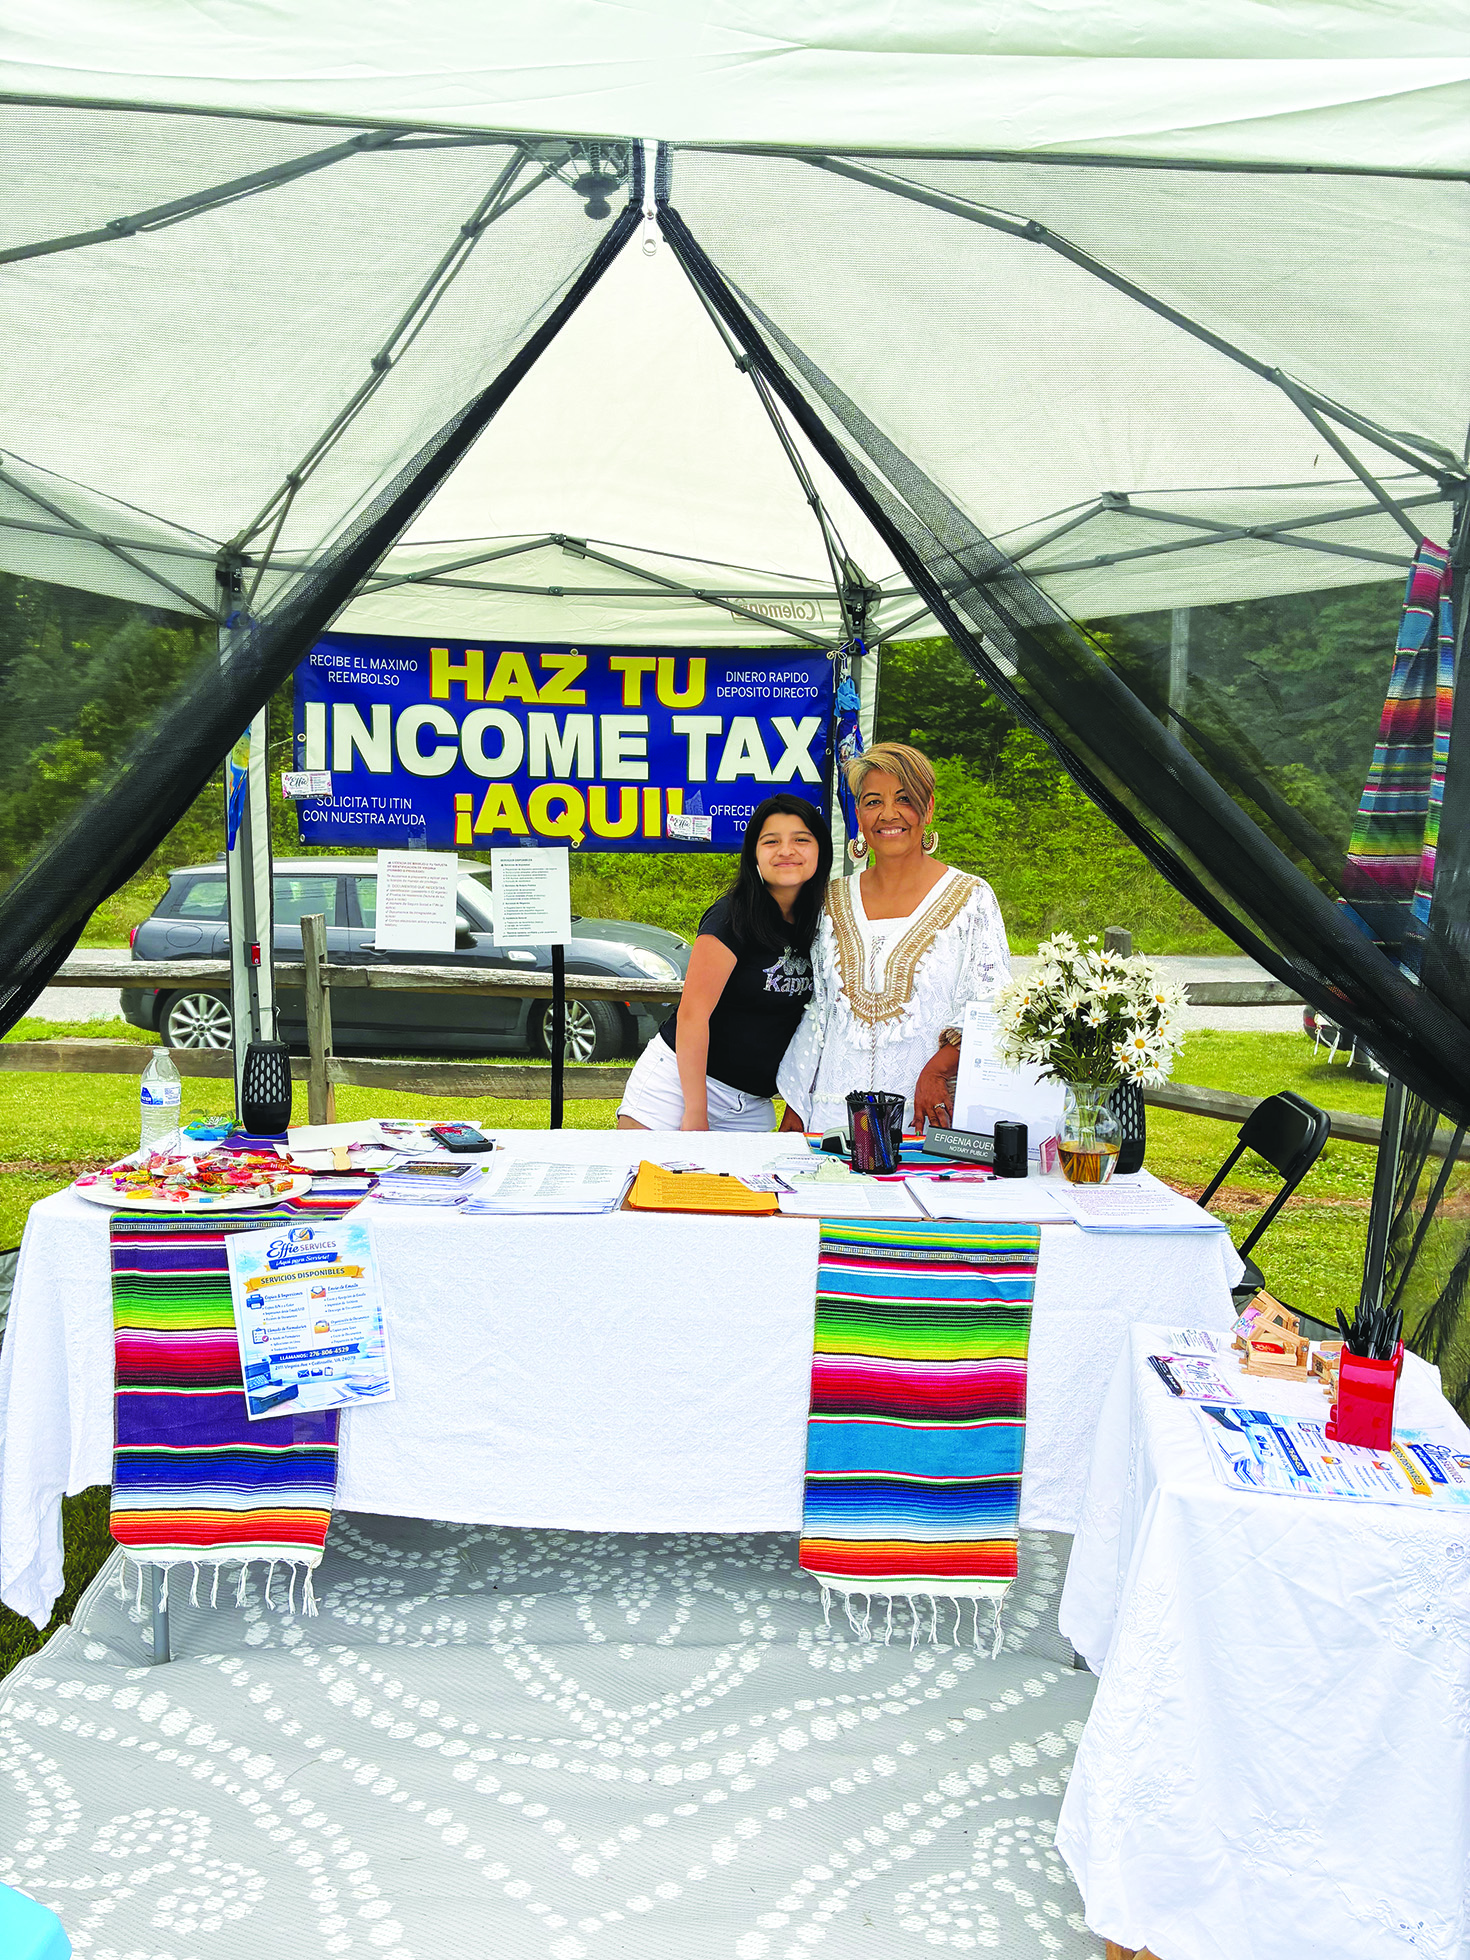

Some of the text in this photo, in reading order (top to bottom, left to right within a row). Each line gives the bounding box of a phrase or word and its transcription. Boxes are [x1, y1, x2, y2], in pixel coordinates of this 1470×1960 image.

[309, 654, 418, 672] RECIBE EL MAXIMO
[328, 671, 400, 686] REEMBOLSO
[429, 647, 708, 709] HAZ TU
[726, 671, 809, 683] DINERO RAPIDO
[717, 686, 818, 698] DEPOSITO DIRECTO
[304, 701, 823, 785] INCOME TAX
[316, 796, 412, 809] SOLICITA TU ITIN
[302, 809, 426, 826] CON NUESTRA AYUDA
[453, 782, 684, 845] ¡AQUI!
[934, 1133, 971, 1147] EFIGENIA
[949, 1145, 988, 1157] NOTARY PUBLIC
[266, 1240, 336, 1259] Effie SERVICES
[261, 1267, 345, 1285] SERVICIOS DISPONIBLES
